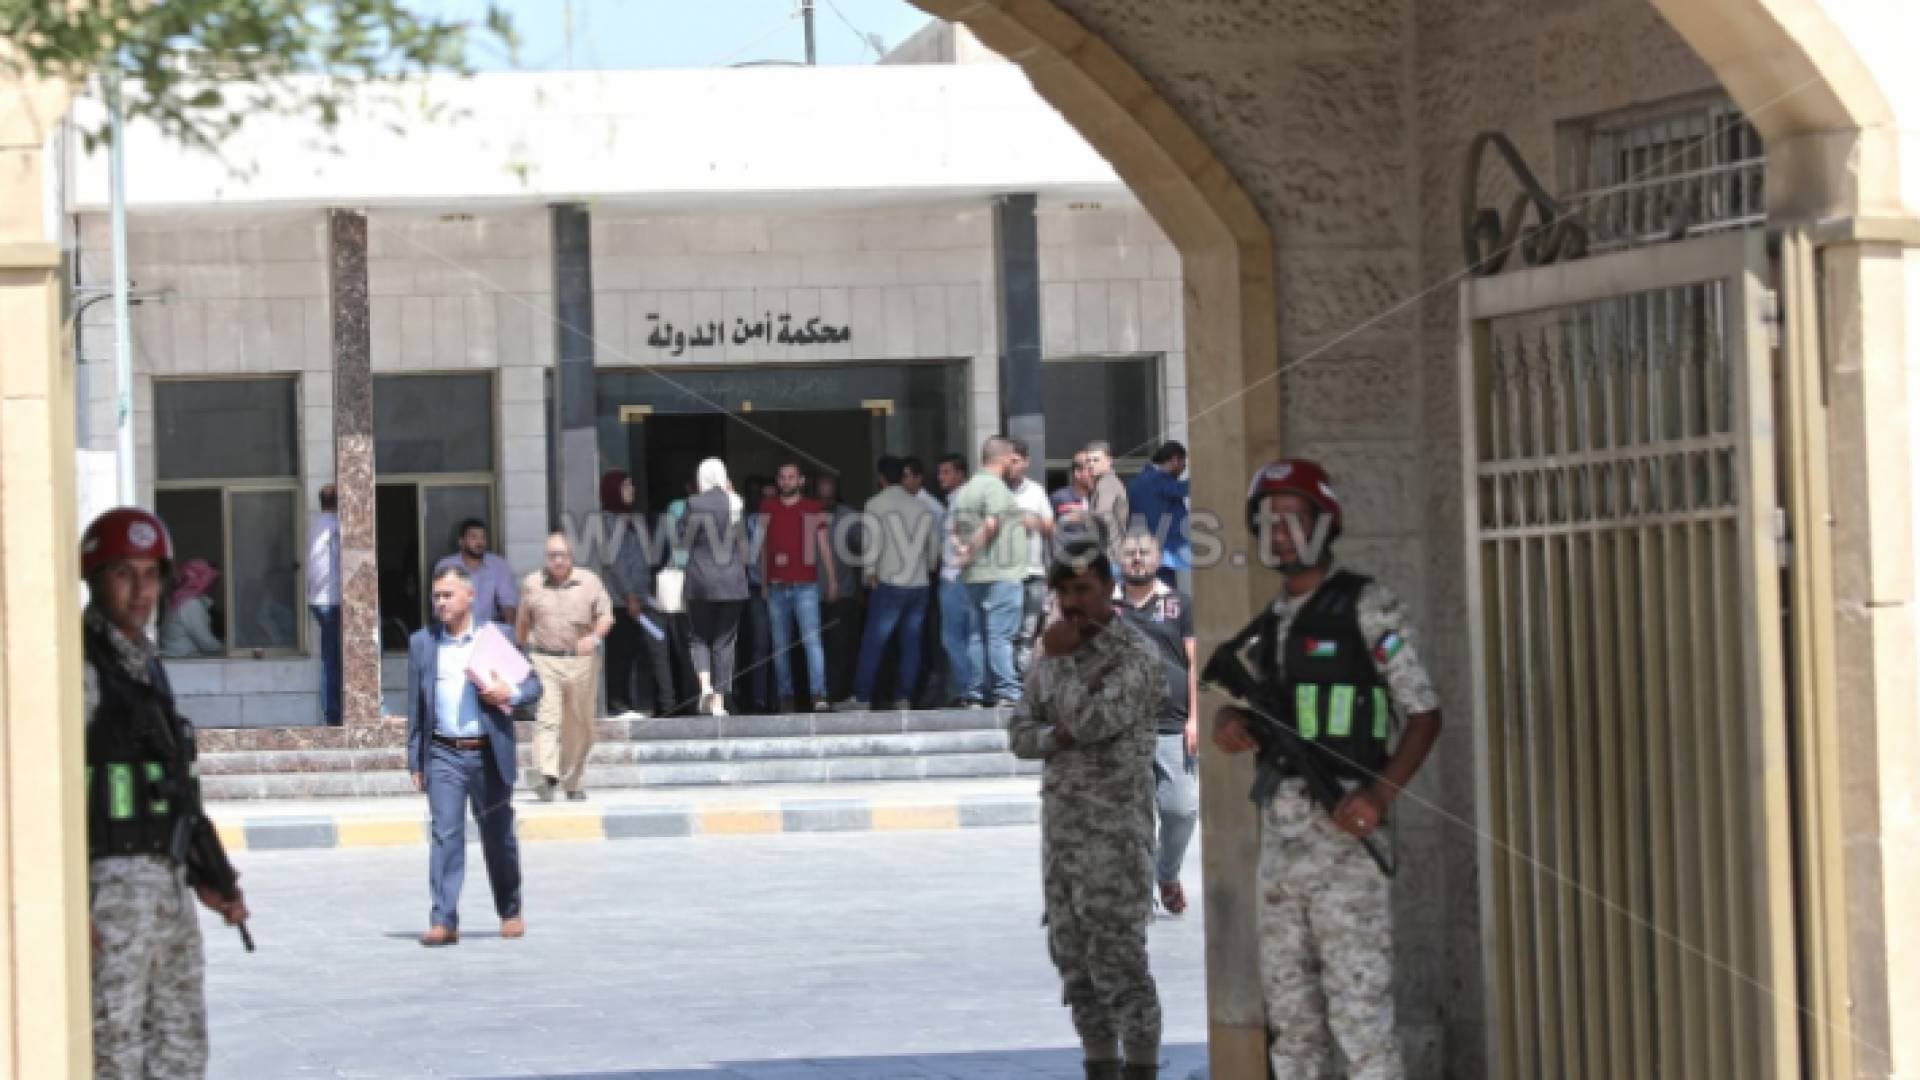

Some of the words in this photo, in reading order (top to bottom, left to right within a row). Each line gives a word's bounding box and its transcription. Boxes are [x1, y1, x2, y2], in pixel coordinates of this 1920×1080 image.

[646, 312, 725, 357] الدولة
[732, 309, 772, 345] أمن
[777, 313, 850, 345] محكمة
